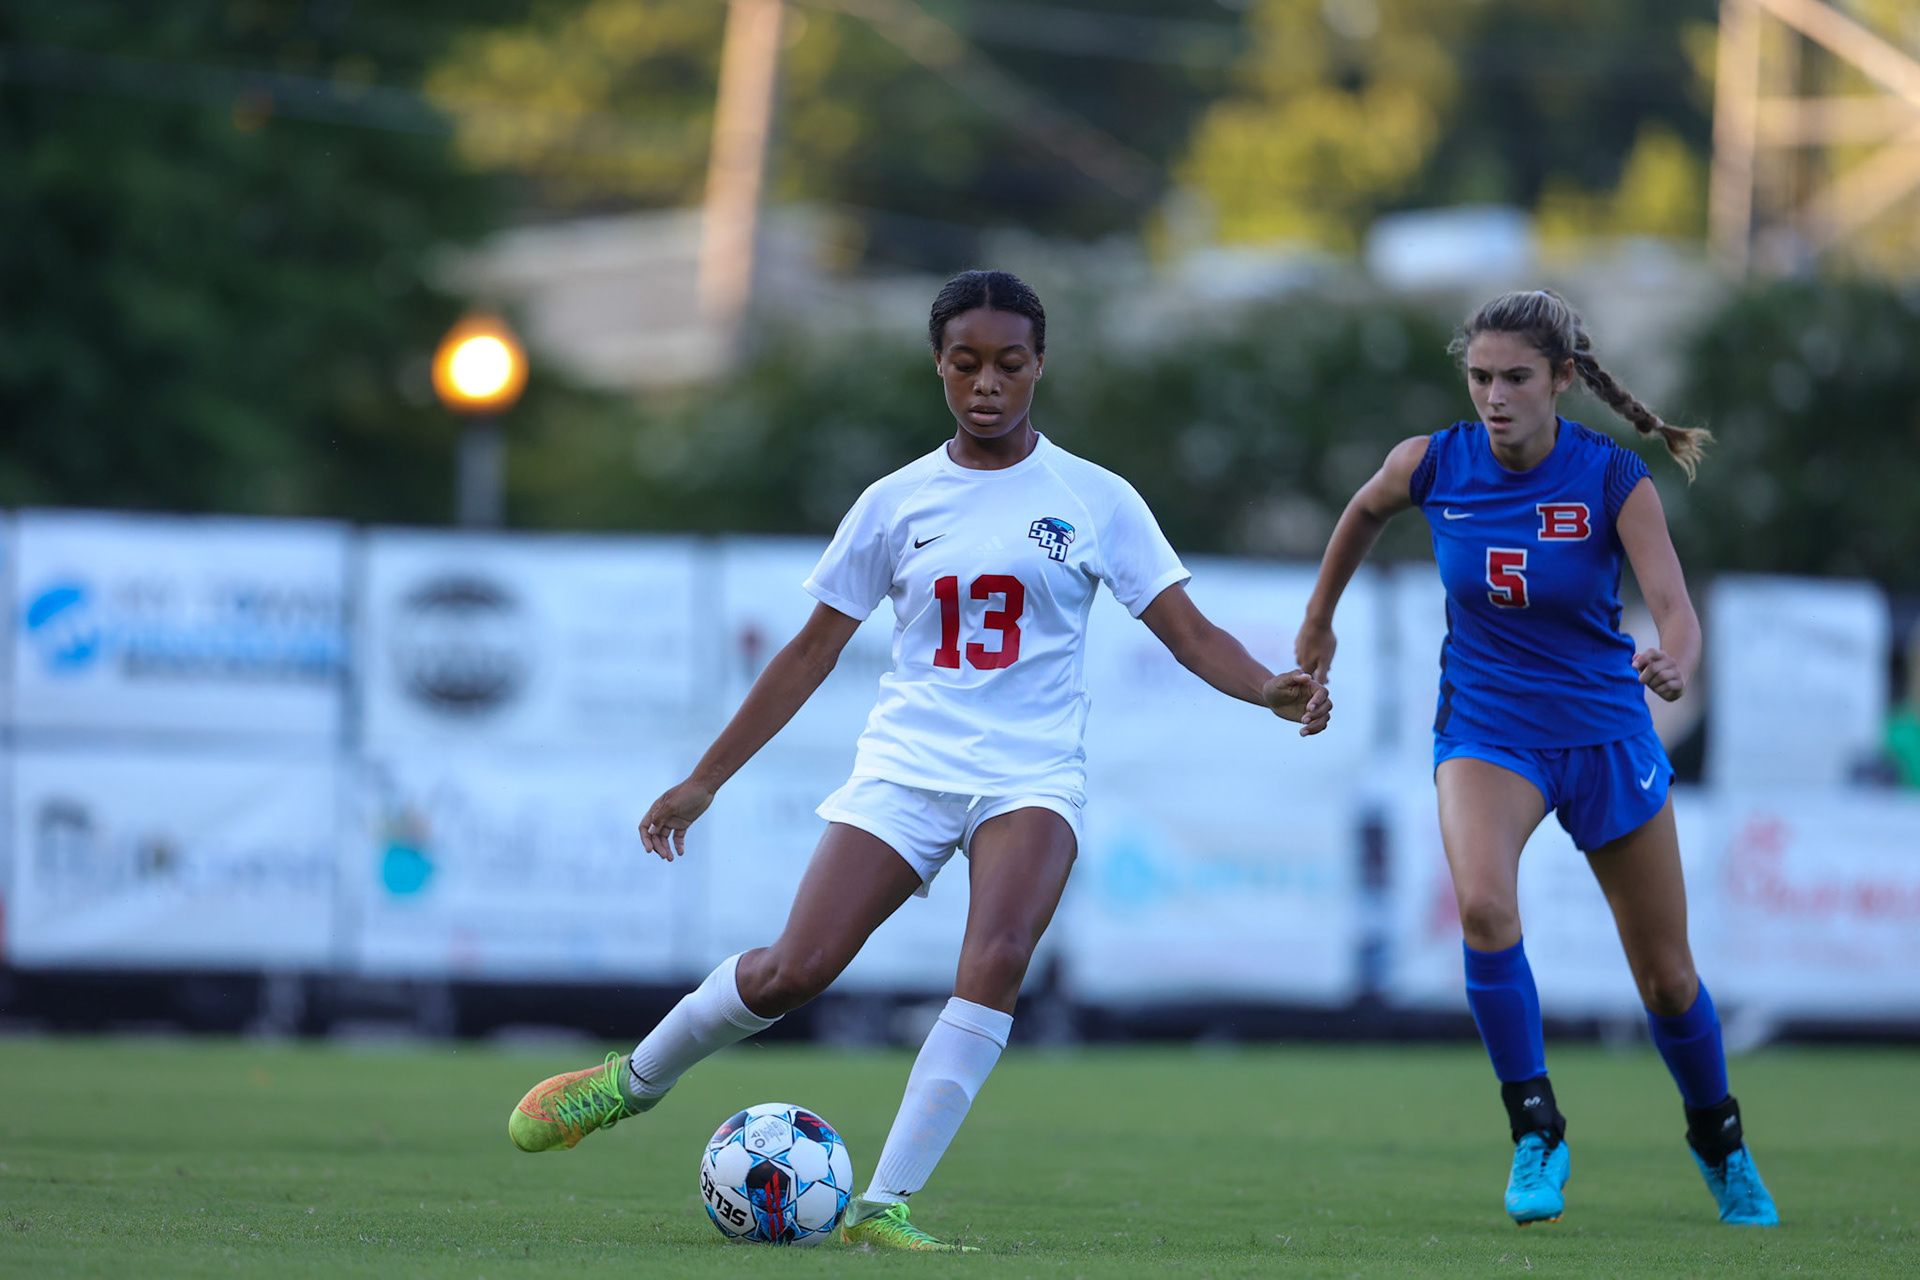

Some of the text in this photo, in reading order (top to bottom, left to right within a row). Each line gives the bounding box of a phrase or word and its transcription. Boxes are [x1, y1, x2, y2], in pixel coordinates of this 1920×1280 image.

[1029, 521, 1069, 563] SBA
[1536, 502, 1591, 542] B
[1486, 546, 1530, 609] 5
[933, 574, 1025, 670] 13
